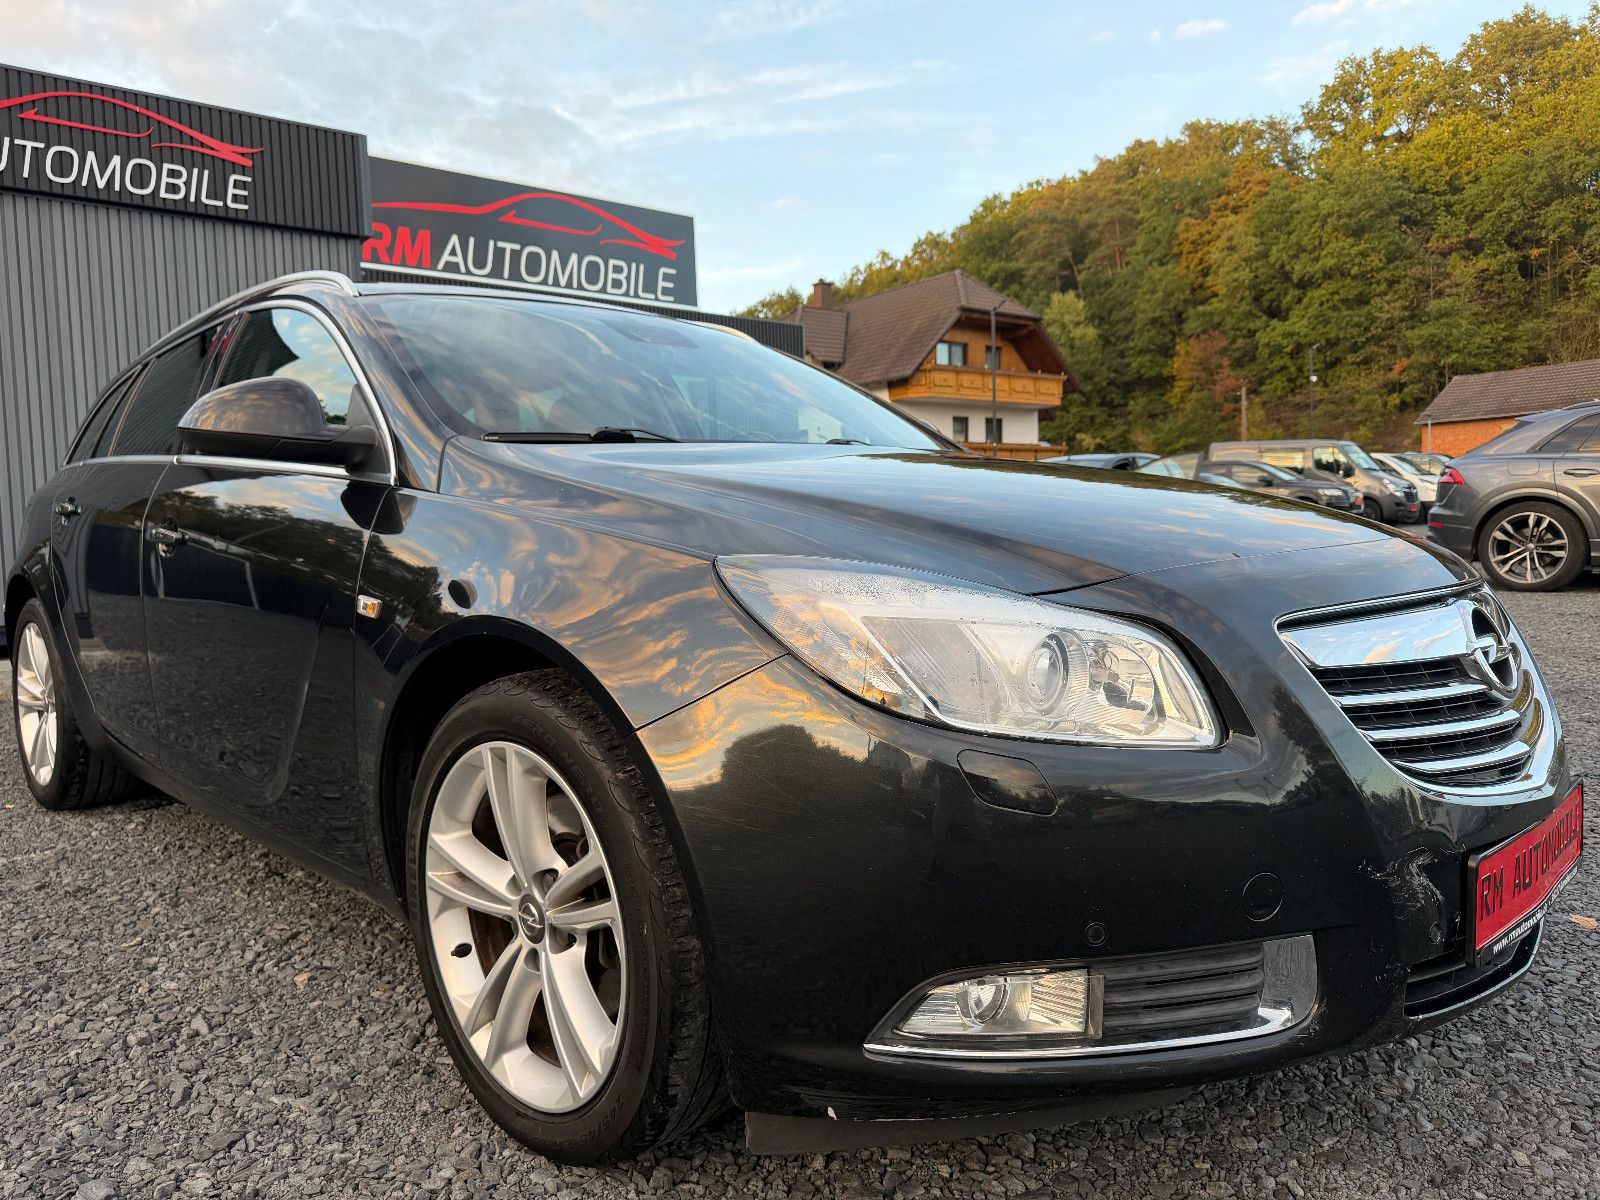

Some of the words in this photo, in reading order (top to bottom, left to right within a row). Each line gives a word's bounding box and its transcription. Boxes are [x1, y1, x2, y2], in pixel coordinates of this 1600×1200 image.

[362, 222, 431, 269] RM
[437, 234, 677, 302] AUTOMOBILE
[1480, 866, 1504, 922] RM
[1513, 800, 1580, 898] AUTOMOBILE
